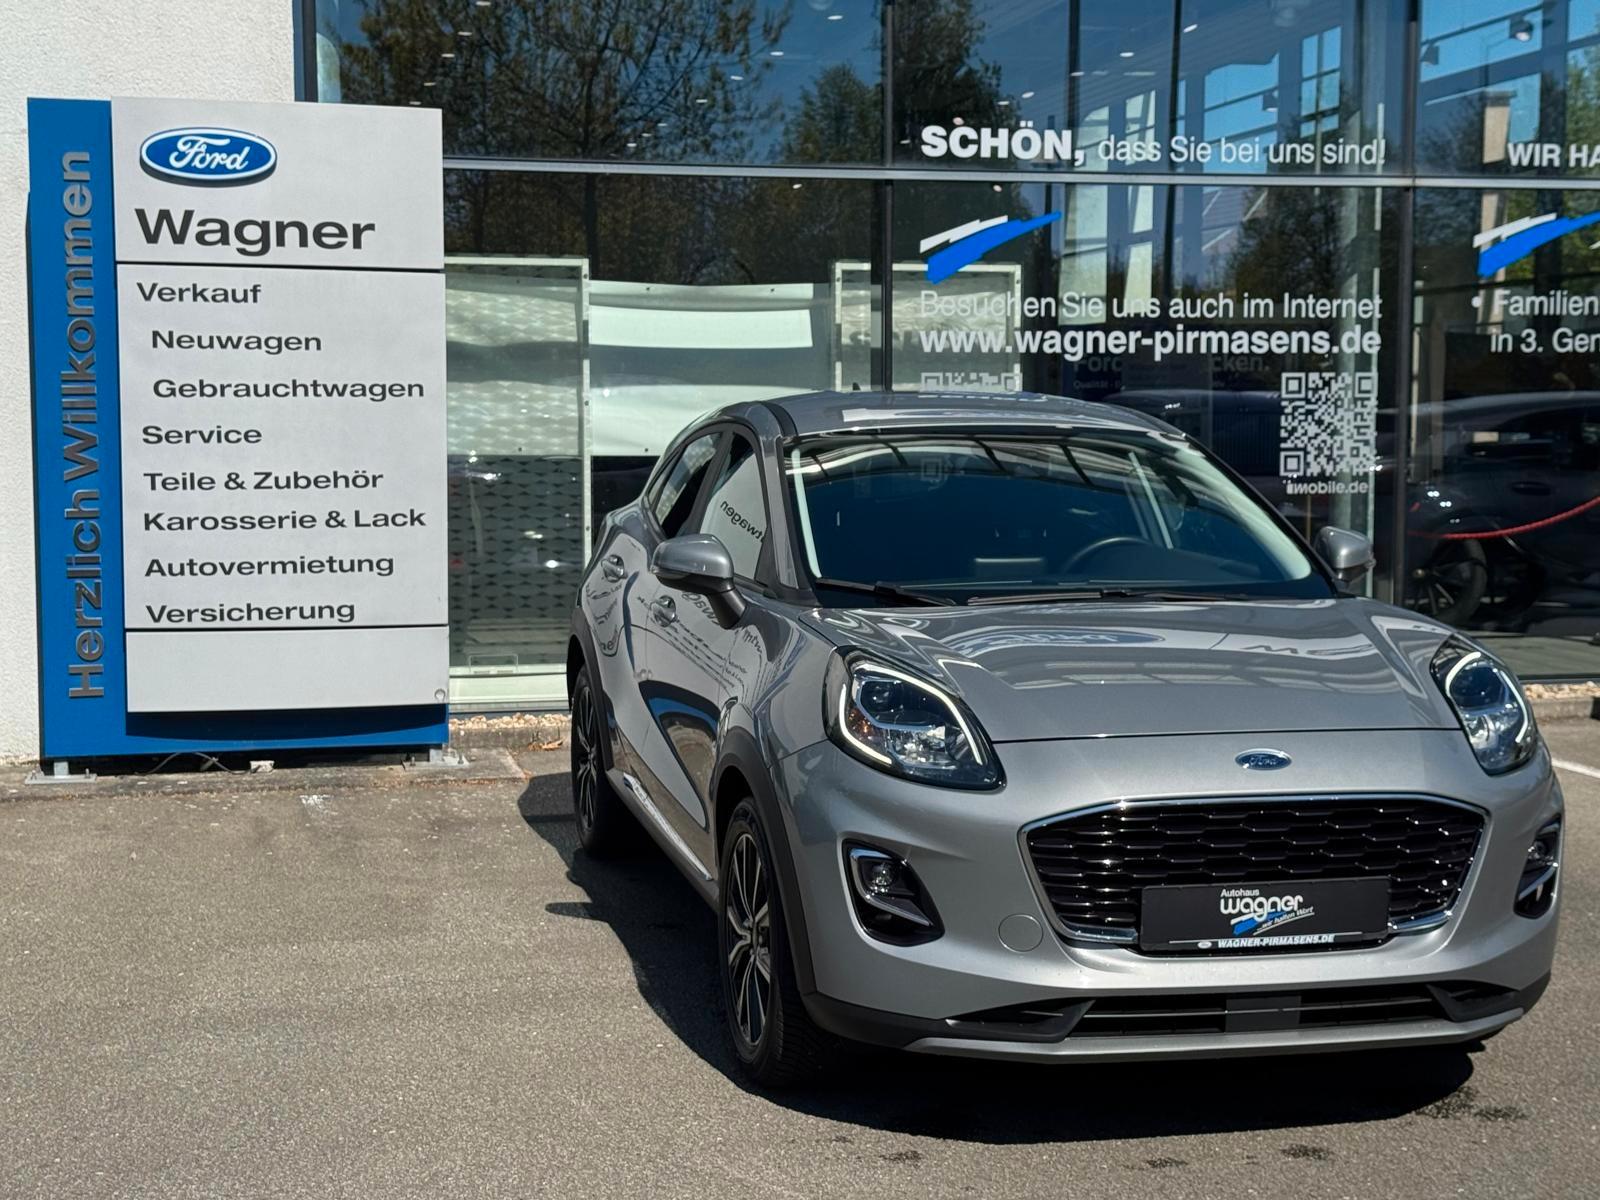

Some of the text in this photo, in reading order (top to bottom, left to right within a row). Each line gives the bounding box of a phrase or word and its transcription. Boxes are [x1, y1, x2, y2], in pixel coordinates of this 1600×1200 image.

[169, 134, 252, 171] Ford
[920, 121, 1386, 166] SCHÖN, dass Sie bei uns sind!
[1507, 142, 1561, 167] WIR
[135, 208, 376, 257] Wagner
[136, 282, 262, 304] Verkauf
[919, 290, 1382, 319] Besuchen Sie uns auch im Internet
[151, 330, 322, 356] Neuwagen
[919, 324, 1382, 361] www.wagner-pirmasens.de
[1490, 328, 1513, 353] in
[1520, 328, 1544, 353] 3.
[153, 378, 424, 403] Gebrauchtwagen
[60, 151, 105, 698] Herzlich Willkommen
[142, 425, 262, 445] Service
[144, 470, 384, 492] Teile & Zubehör
[143, 508, 426, 531] Karosserie & Lack
[145, 555, 394, 577] Autovermietung
[145, 602, 355, 624] Versicherung
[1220, 888, 1260, 898] Autohaus
[1220, 895, 1304, 922] wagner
[1218, 934, 1335, 949] WAGNER-PIRMASENS.DE
